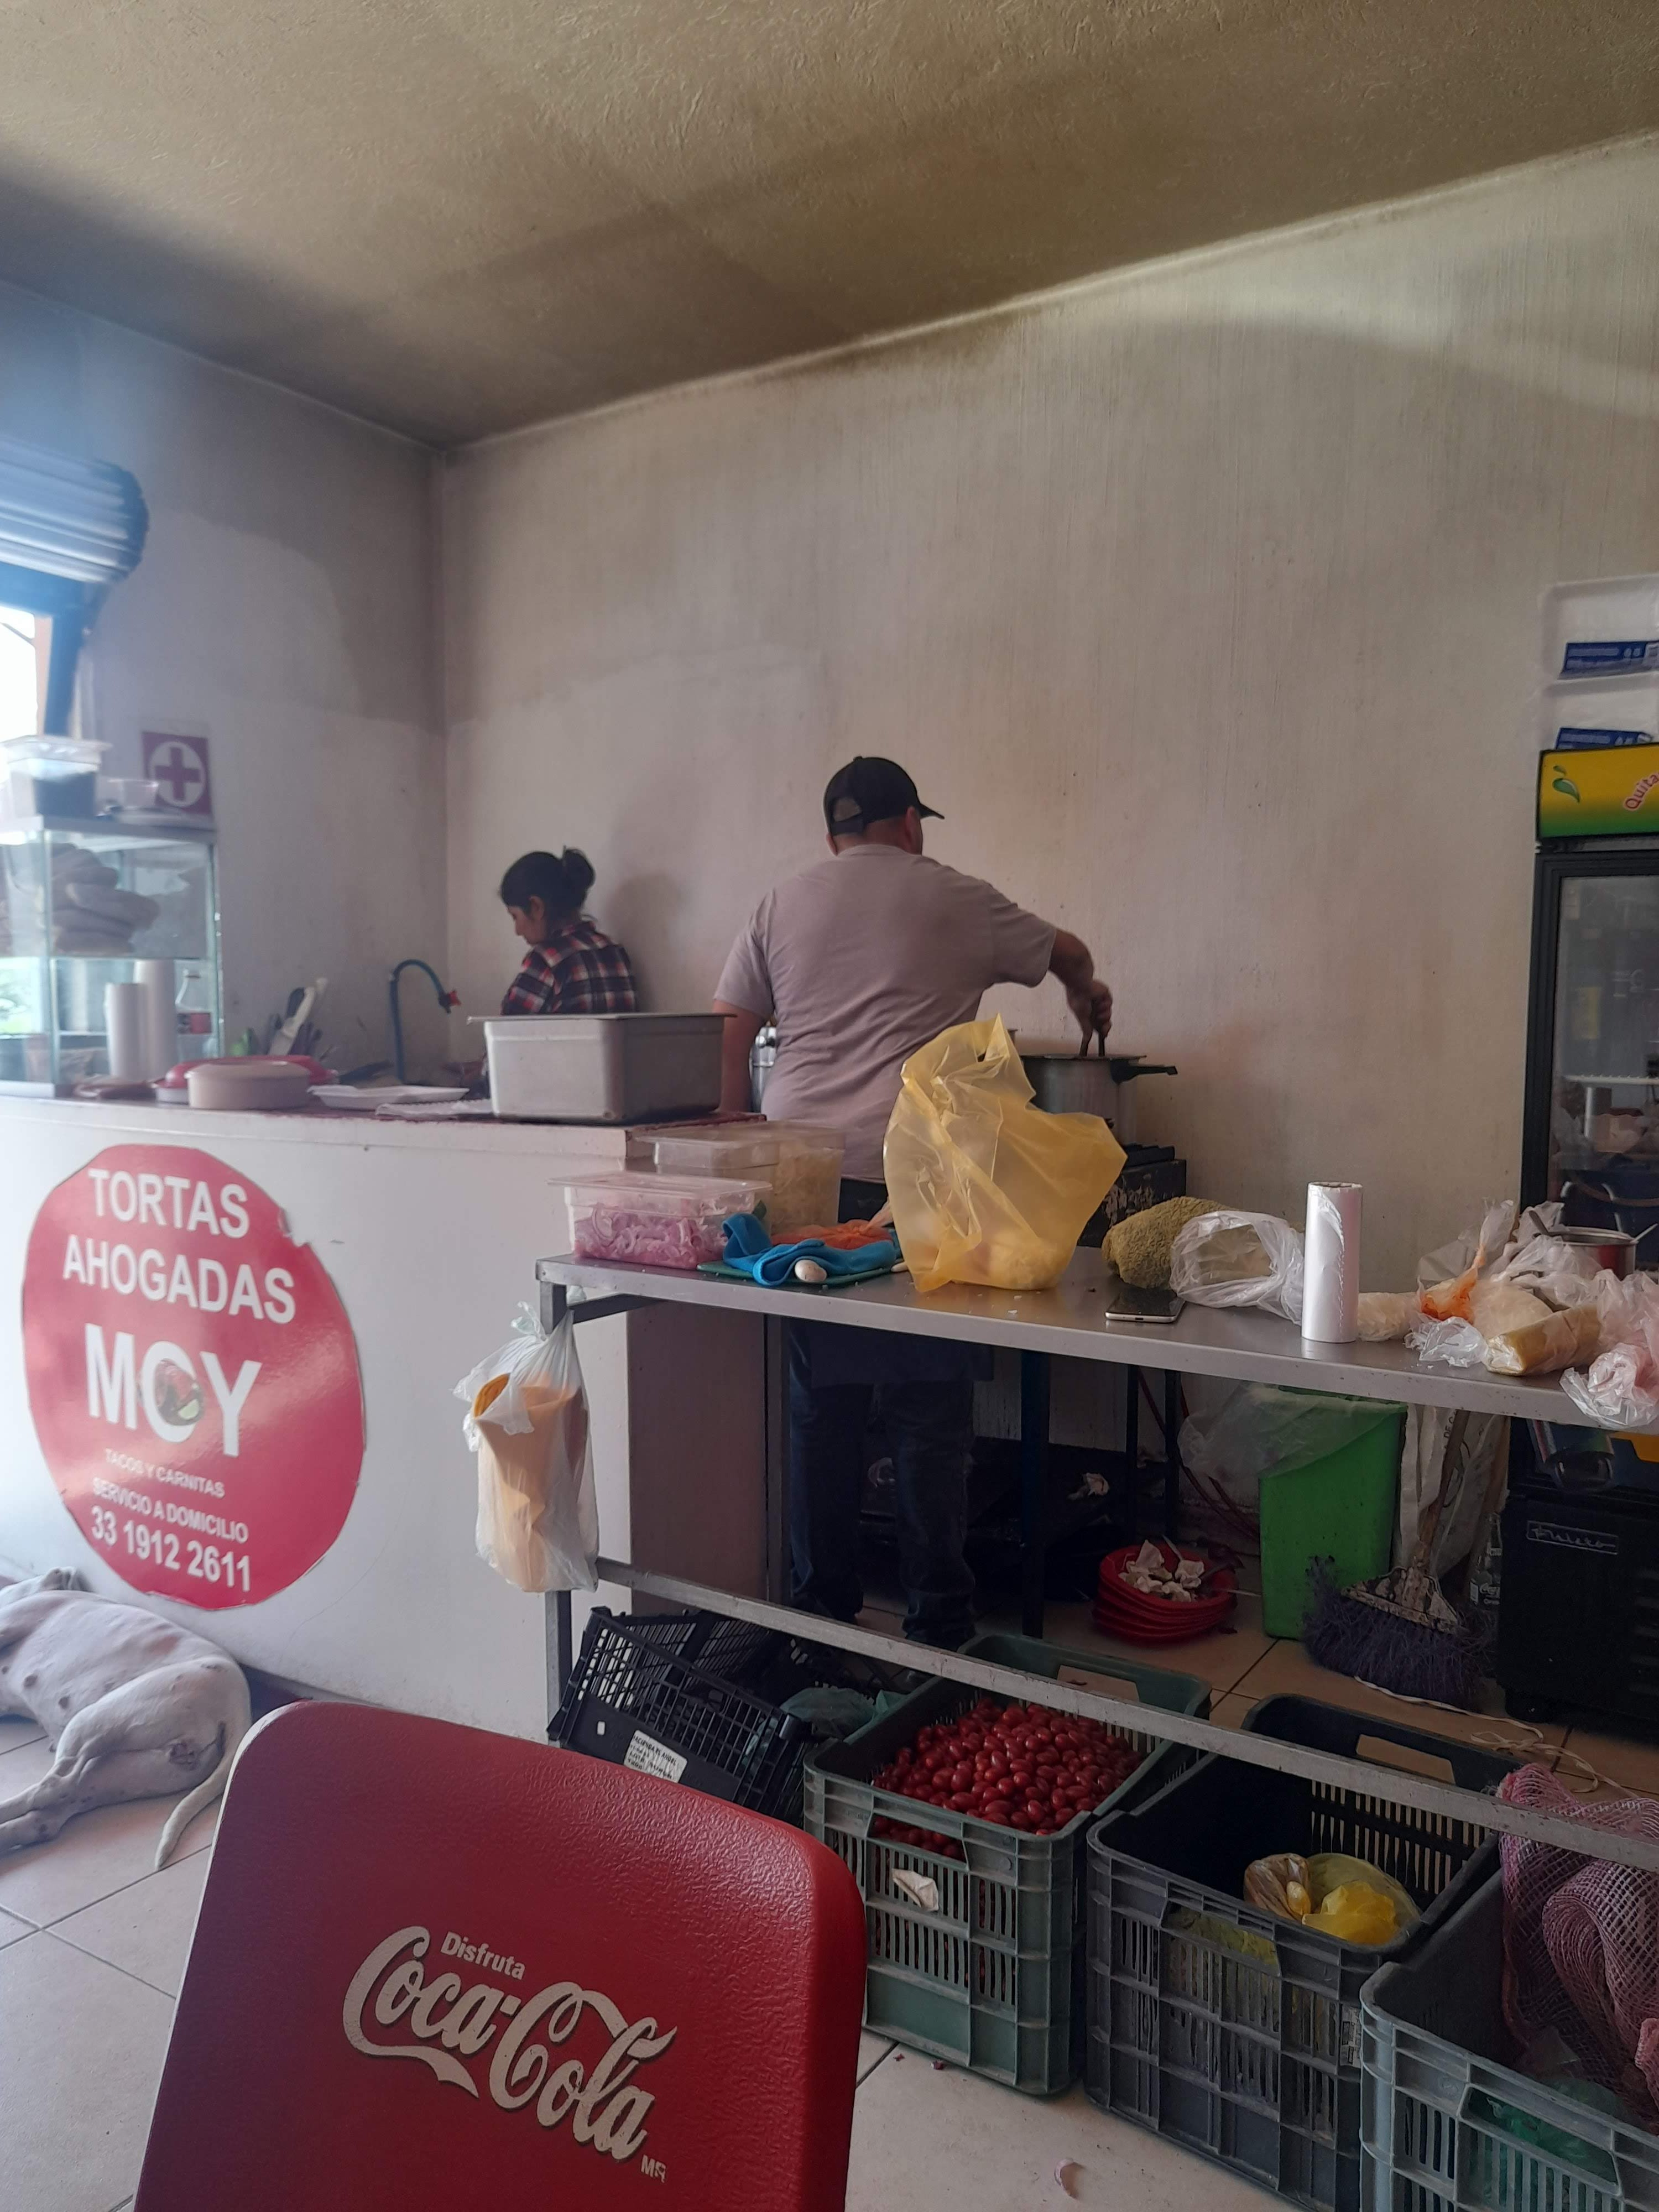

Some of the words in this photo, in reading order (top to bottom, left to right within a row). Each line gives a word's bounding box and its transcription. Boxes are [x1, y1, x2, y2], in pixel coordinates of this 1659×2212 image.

[88, 1167, 250, 1239] TORTAS
[62, 1234, 296, 1324] AHOGADAS
[85, 1323, 262, 1457] MOY
[93, 1477, 152, 1516] SERVICIO
[153, 1499, 165, 1520] A
[165, 1503, 249, 1544] DOMICILIO
[106, 1448, 144, 1475] TACOS
[145, 1464, 155, 1478] Y
[156, 1467, 226, 1499] CARNITAS
[91, 1505, 117, 1546] 33
[123, 1520, 180, 1572] 1912
[186, 1540, 251, 1592] 2611
[440, 1932, 526, 1980] Disfruta
[342, 1926, 677, 2160] Coca-Cola
